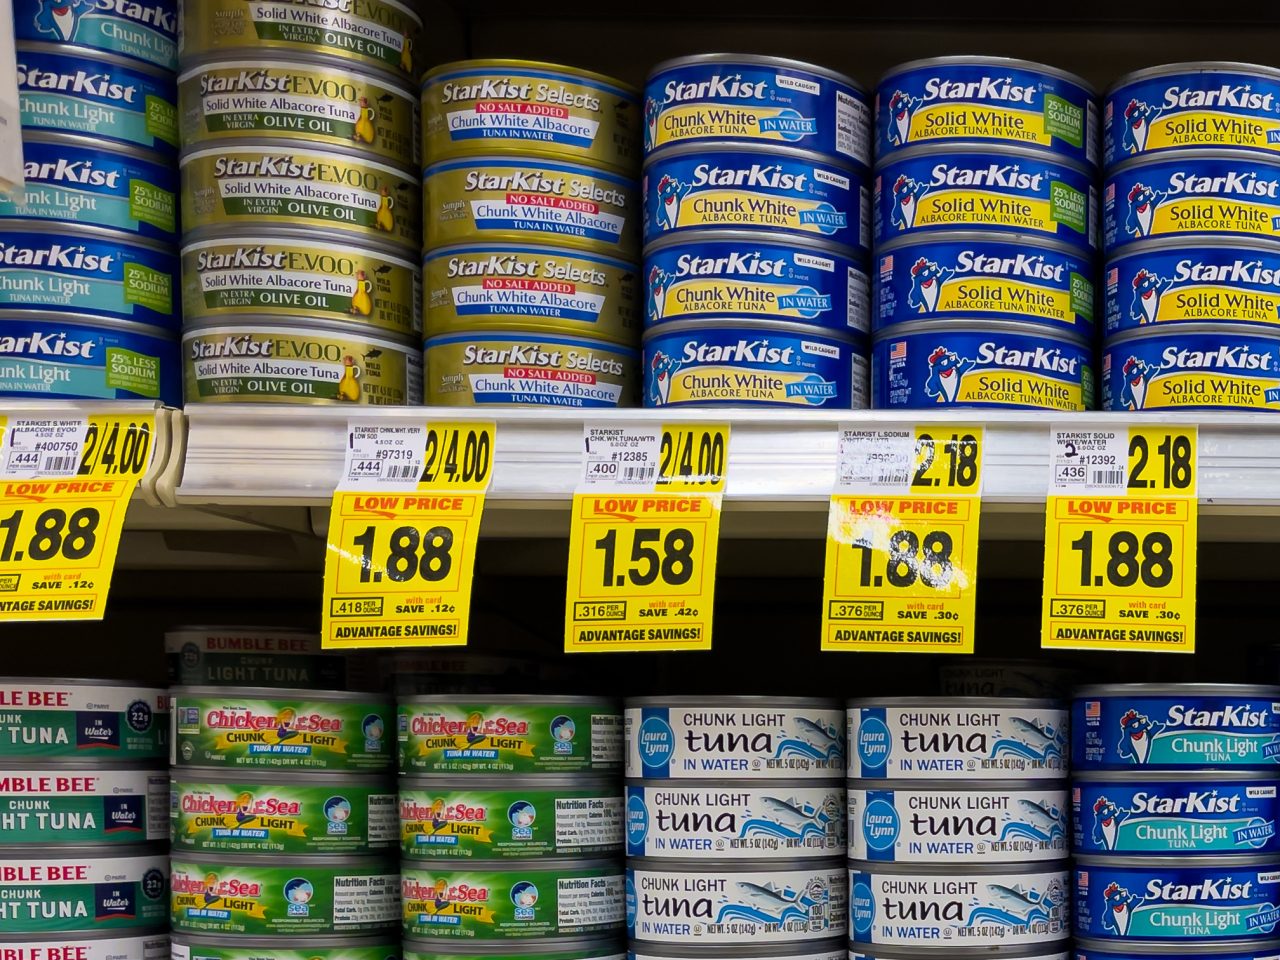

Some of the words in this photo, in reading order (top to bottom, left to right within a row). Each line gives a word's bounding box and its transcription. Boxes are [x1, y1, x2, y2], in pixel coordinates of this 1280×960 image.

[663, 75, 767, 102] StarKist
[923, 77, 1036, 104] StarKist
[479, 103, 494, 113] NO
[499, 104, 524, 114] SALT
[528, 107, 564, 117] ADDED
[451, 116, 487, 127] Chunk
[491, 116, 528, 129] White
[532, 119, 591, 135] Albacore
[664, 113, 703, 128] Chunk
[707, 112, 756, 127] White
[670, 126, 716, 137] ALBACORE
[718, 125, 747, 134] TUNA
[224, 182, 251, 196] Solid
[255, 184, 291, 198] White
[295, 186, 348, 203] Albacore
[352, 194, 377, 208] Tuna
[287, 201, 329, 218] OLIVE
[333, 207, 356, 220] OIL
[35, 442, 77, 451] #400750
[376, 450, 412, 459] #97319
[419, 430, 489, 482] 2/4.00
[612, 452, 647, 461] #12385
[912, 434, 977, 486] 2.18
[1080, 455, 1116, 464] #12392
[1128, 435, 1192, 488] 2.18
[589, 464, 616, 473] .400
[1068, 501, 1111, 514] LOW
[1118, 502, 1176, 514] PRICE
[0, 508, 100, 561] 1.88
[354, 526, 453, 583] 1.88
[595, 528, 694, 586] 1.58
[1072, 531, 1173, 588] 1.88
[835, 605, 862, 616] .376
[336, 626, 401, 638] ADVANTAGE
[405, 625, 456, 636] SAVINGS!
[206, 636, 273, 651] BUMBLE
[278, 638, 310, 651] BEE
[684, 713, 736, 727] CHUNK
[741, 713, 786, 727] LIGHT
[225, 732, 265, 745] CHUNK
[302, 734, 336, 746] LIGHT
[684, 729, 772, 754] tuna
[684, 759, 697, 770] IN
[701, 759, 748, 771] WATER
[556, 800, 588, 810] Nutrition
[588, 799, 604, 810] Facts
